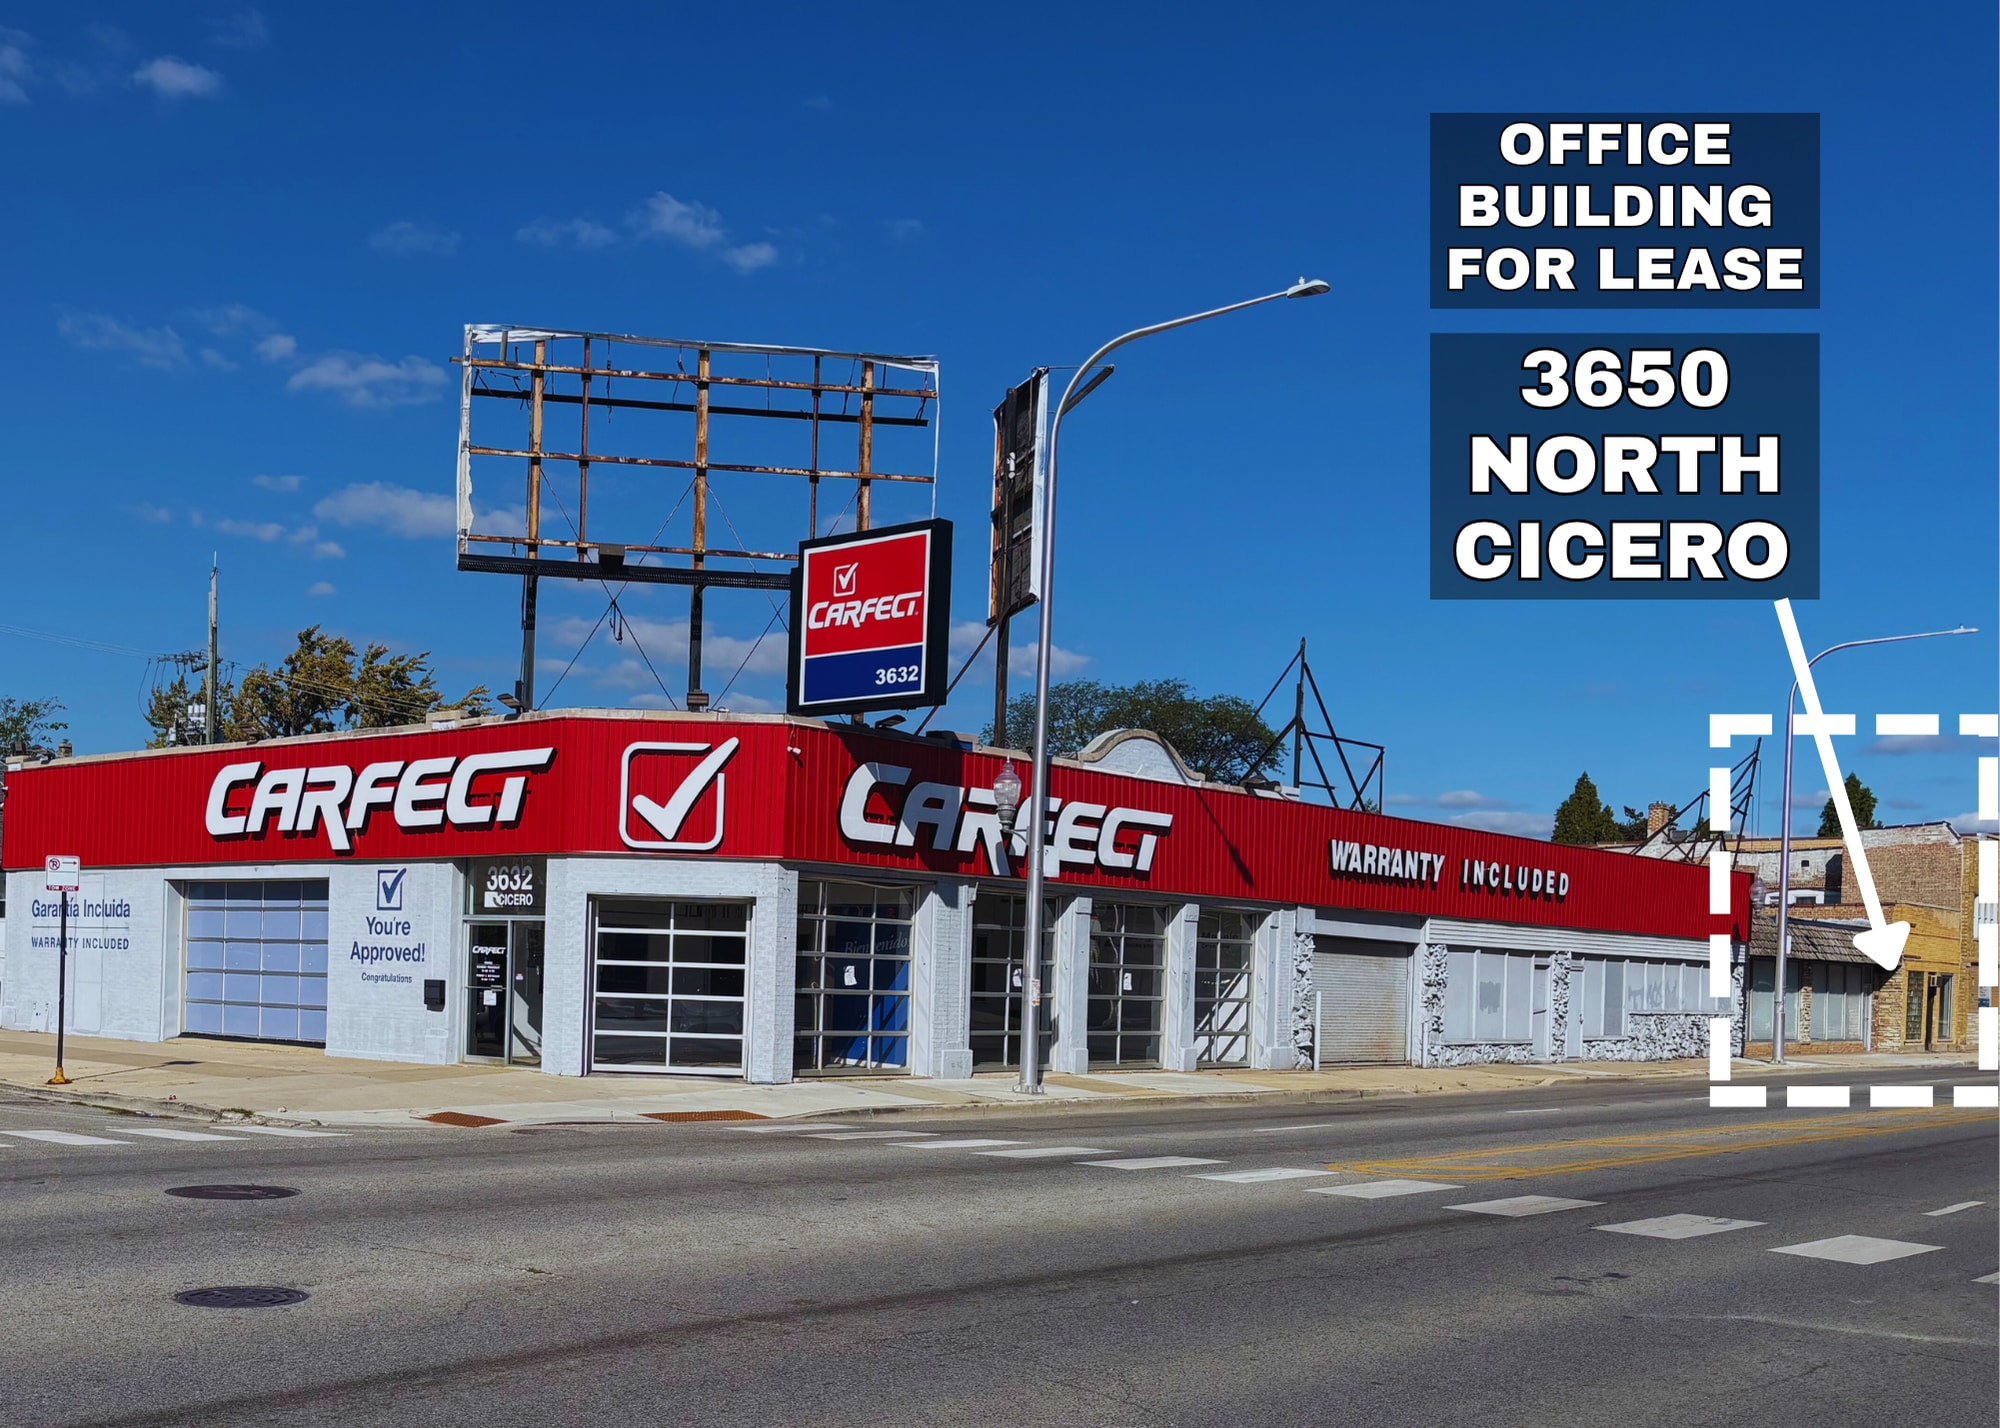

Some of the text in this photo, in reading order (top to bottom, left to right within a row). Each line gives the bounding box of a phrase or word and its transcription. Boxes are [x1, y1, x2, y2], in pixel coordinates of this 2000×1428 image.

[807, 590, 924, 630] CARFECT
[874, 664, 920, 686] 3632
[205, 746, 556, 852] CARFECT
[486, 865, 533, 891] 3632
[1330, 838, 1570, 897] WARRANTY INCLUDED
[83, 898, 131, 918] Incluida
[499, 893, 533, 906] CICERO
[365, 916, 411, 936] You're
[82, 937, 130, 950] INCLUDED
[350, 940, 426, 965] Approved!
[361, 971, 413, 984] Congratulations
